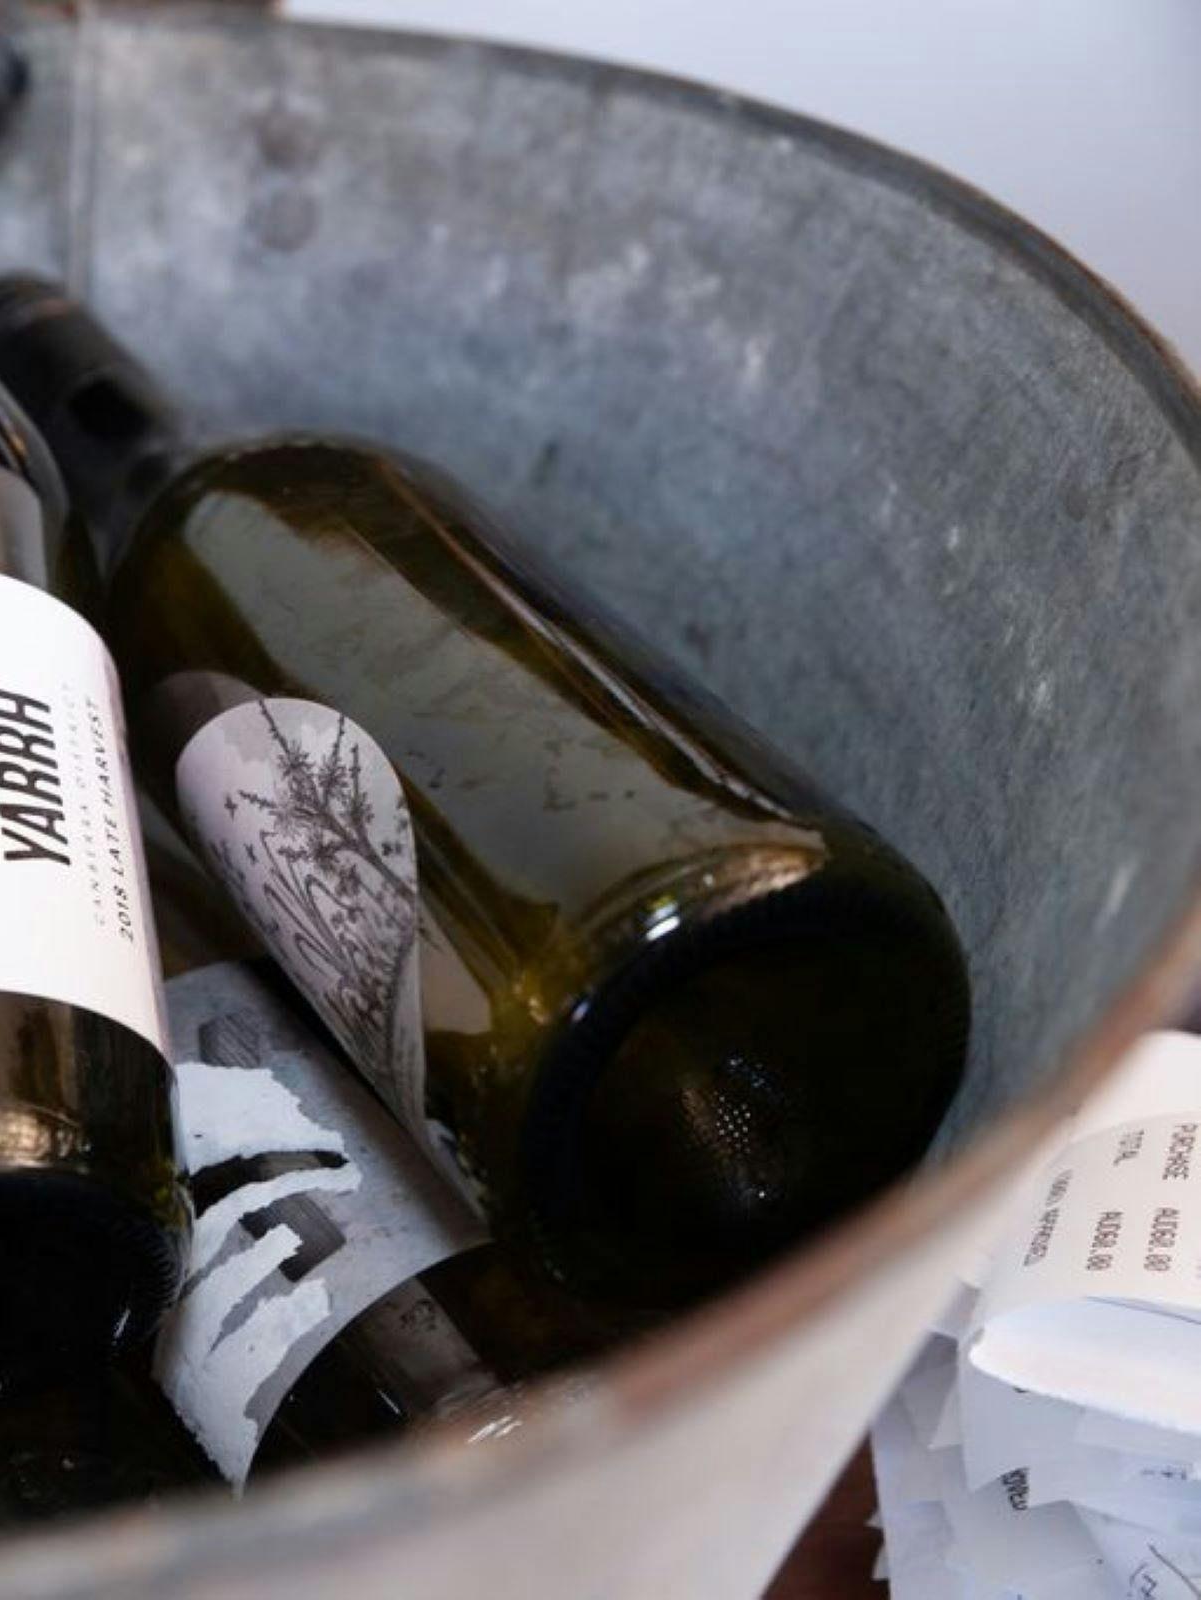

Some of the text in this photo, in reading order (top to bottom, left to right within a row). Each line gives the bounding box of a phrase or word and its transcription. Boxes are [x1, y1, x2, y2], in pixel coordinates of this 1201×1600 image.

[84, 696, 134, 943] 2018 LATE HARVEST
[1162, 1123, 1198, 1180] PURCHASE
